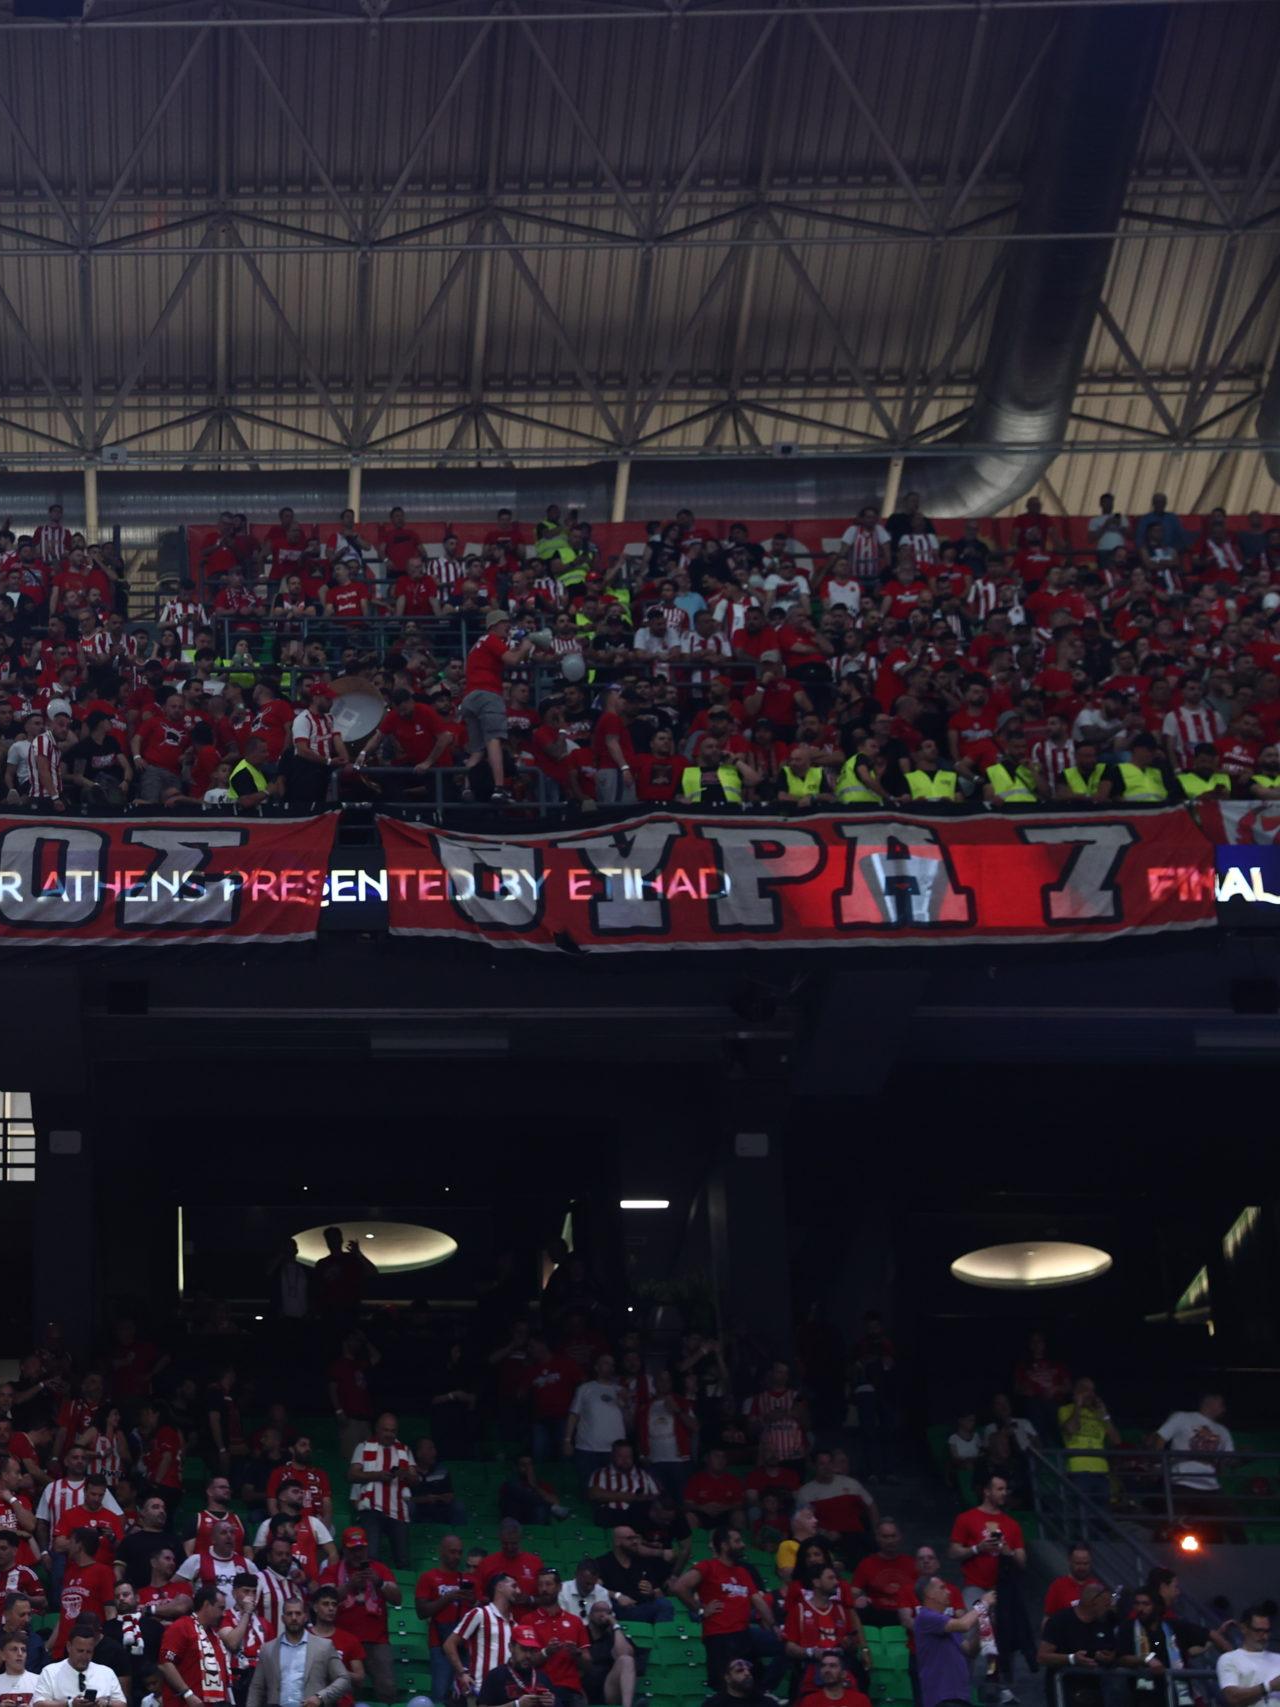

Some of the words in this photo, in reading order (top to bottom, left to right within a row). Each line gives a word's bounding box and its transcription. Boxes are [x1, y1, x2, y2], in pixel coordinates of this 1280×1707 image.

[41, 870, 208, 903] ATHENS
[222, 869, 477, 908] PRESENTED
[493, 868, 551, 901] BY
[568, 868, 732, 901] ETIHAD
[1017, 821, 1138, 927] 7
